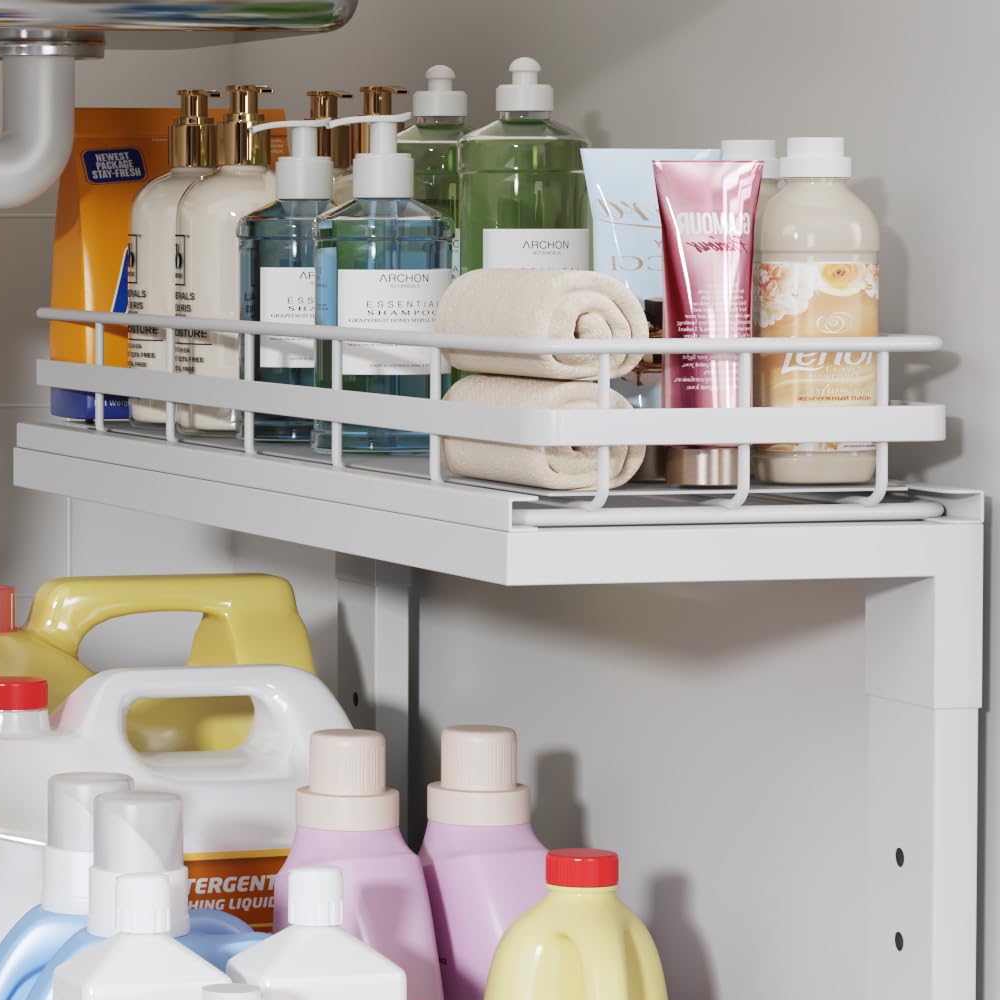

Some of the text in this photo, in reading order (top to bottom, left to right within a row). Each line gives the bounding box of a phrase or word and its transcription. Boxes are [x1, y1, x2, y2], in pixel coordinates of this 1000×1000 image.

[95, 152, 129, 162] NEWEST
[95, 160, 134, 170] PACKAGE
[91, 168, 142, 179] STAY-FRESH
[522, 240, 570, 250] ARCHON
[379, 273, 429, 283] ARCHON
[187, 874, 278, 894] TERGENT
[188, 899, 226, 910] HING
